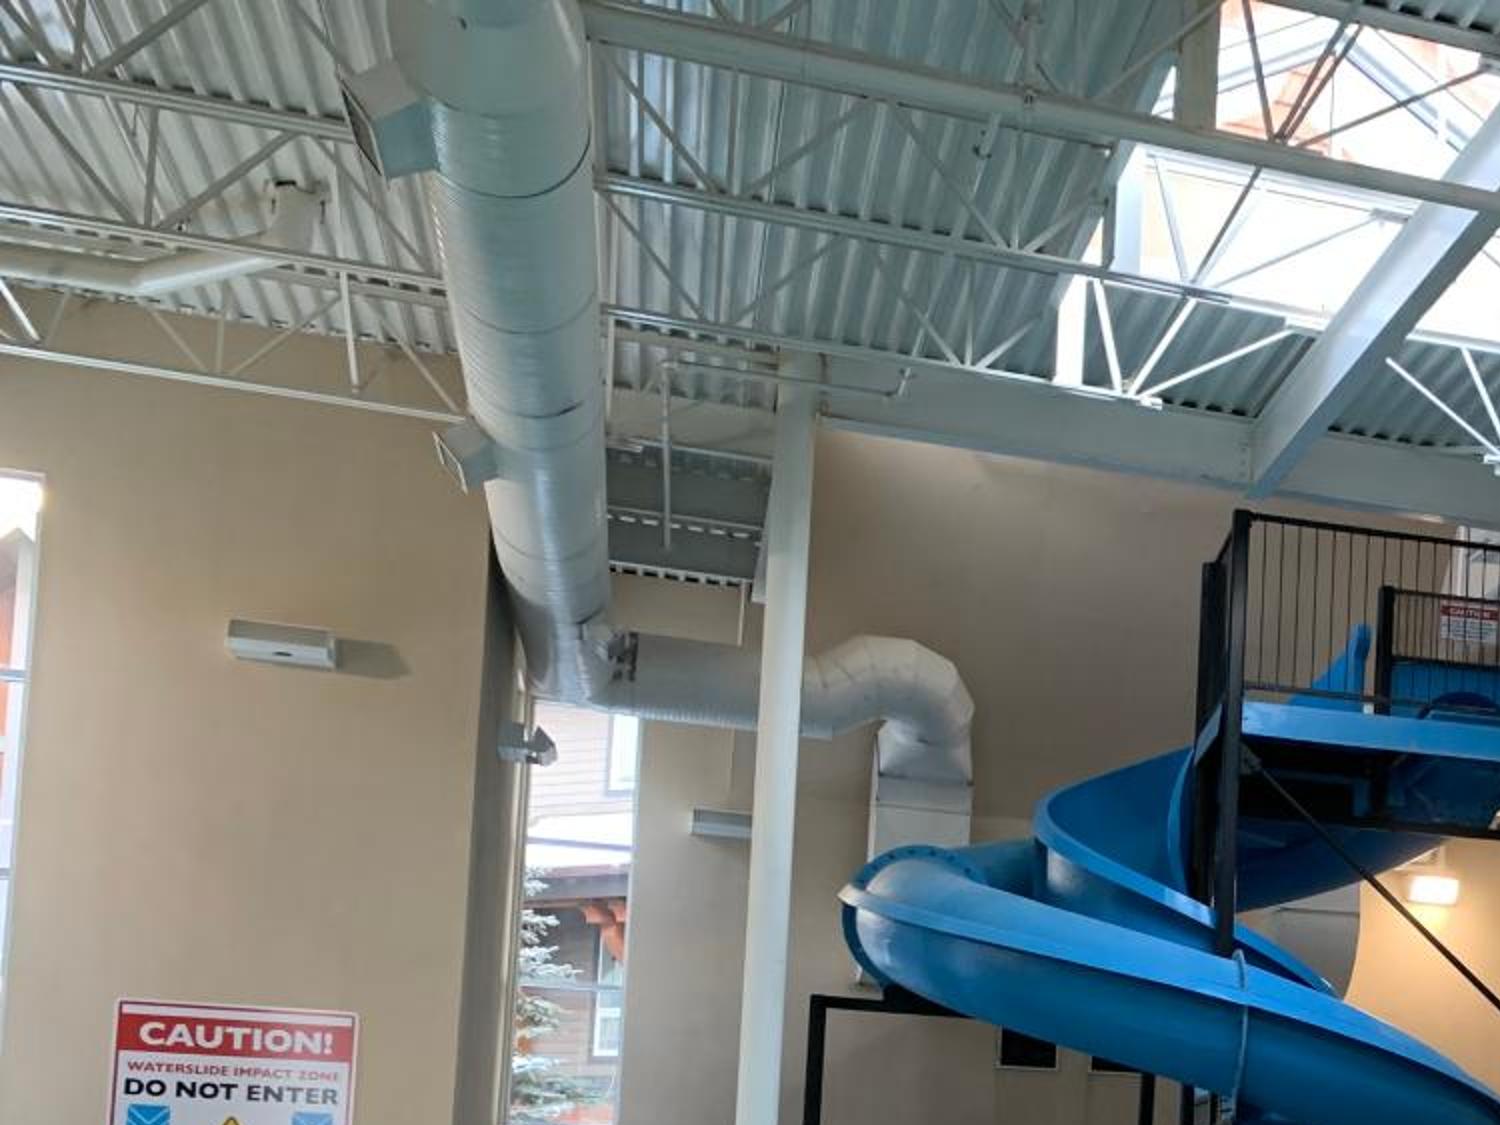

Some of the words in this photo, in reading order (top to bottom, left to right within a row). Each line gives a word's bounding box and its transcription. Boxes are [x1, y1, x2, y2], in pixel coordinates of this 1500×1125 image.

[139, 1021, 333, 1055] CAUTION!
[127, 1060, 228, 1077] WATERSLIDE
[233, 1065, 293, 1080] IMPACT
[124, 1078, 167, 1097] DO
[175, 1080, 238, 1100] NOT
[246, 1084, 339, 1105] ENTER
